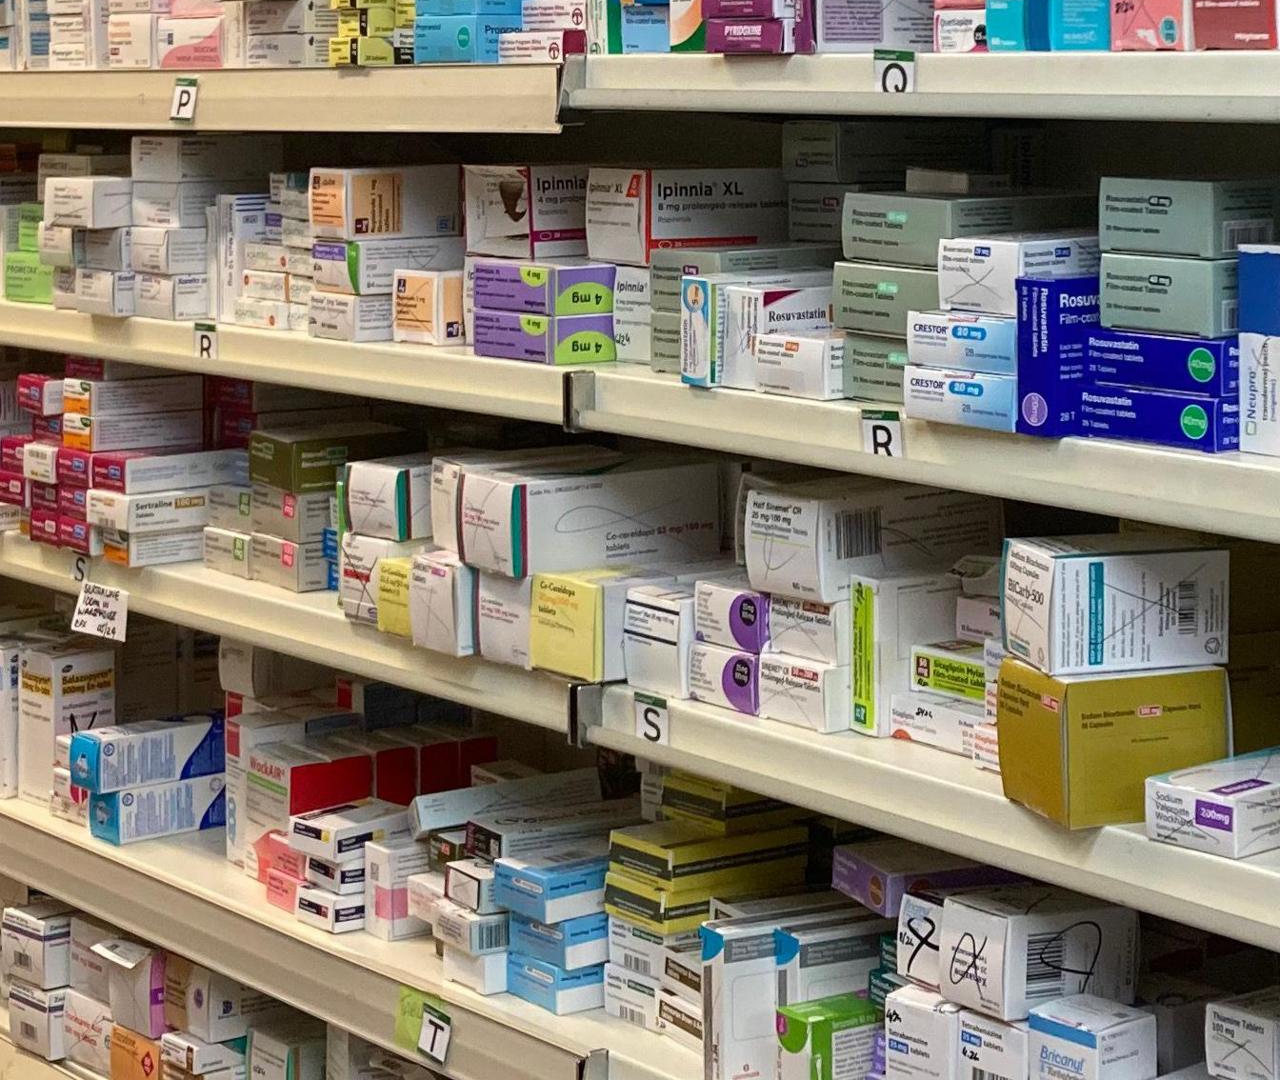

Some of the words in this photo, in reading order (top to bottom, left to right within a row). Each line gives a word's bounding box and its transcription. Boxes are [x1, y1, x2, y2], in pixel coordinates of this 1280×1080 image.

[881, 63, 909, 92] Q
[178, 90, 191, 115] P
[572, 291, 591, 305] mg
[595, 293, 602, 305] 4
[768, 308, 826, 322] Rosuvastatin
[1040, 288, 1048, 352] Rosuvastatin
[913, 323, 947, 334] CRESTOR
[957, 327, 969, 337] 20
[572, 340, 591, 354] mg
[595, 342, 602, 354] 4
[1089, 337, 1139, 351] Rosuvastatin
[1089, 350, 1126, 361] Film-coated
[1082, 392, 1132, 407] Rosuvastatin
[872, 425, 894, 455] R
[75, 557, 86, 581] S
[644, 707, 661, 742] S
[1155, 790, 1183, 806] Sodium
[1200, 806, 1231, 825] 200mg
[1242, 1018, 1265, 1034] Tablets
[429, 1021, 446, 1053] T
[1039, 1044, 1084, 1071] Bricanyl
